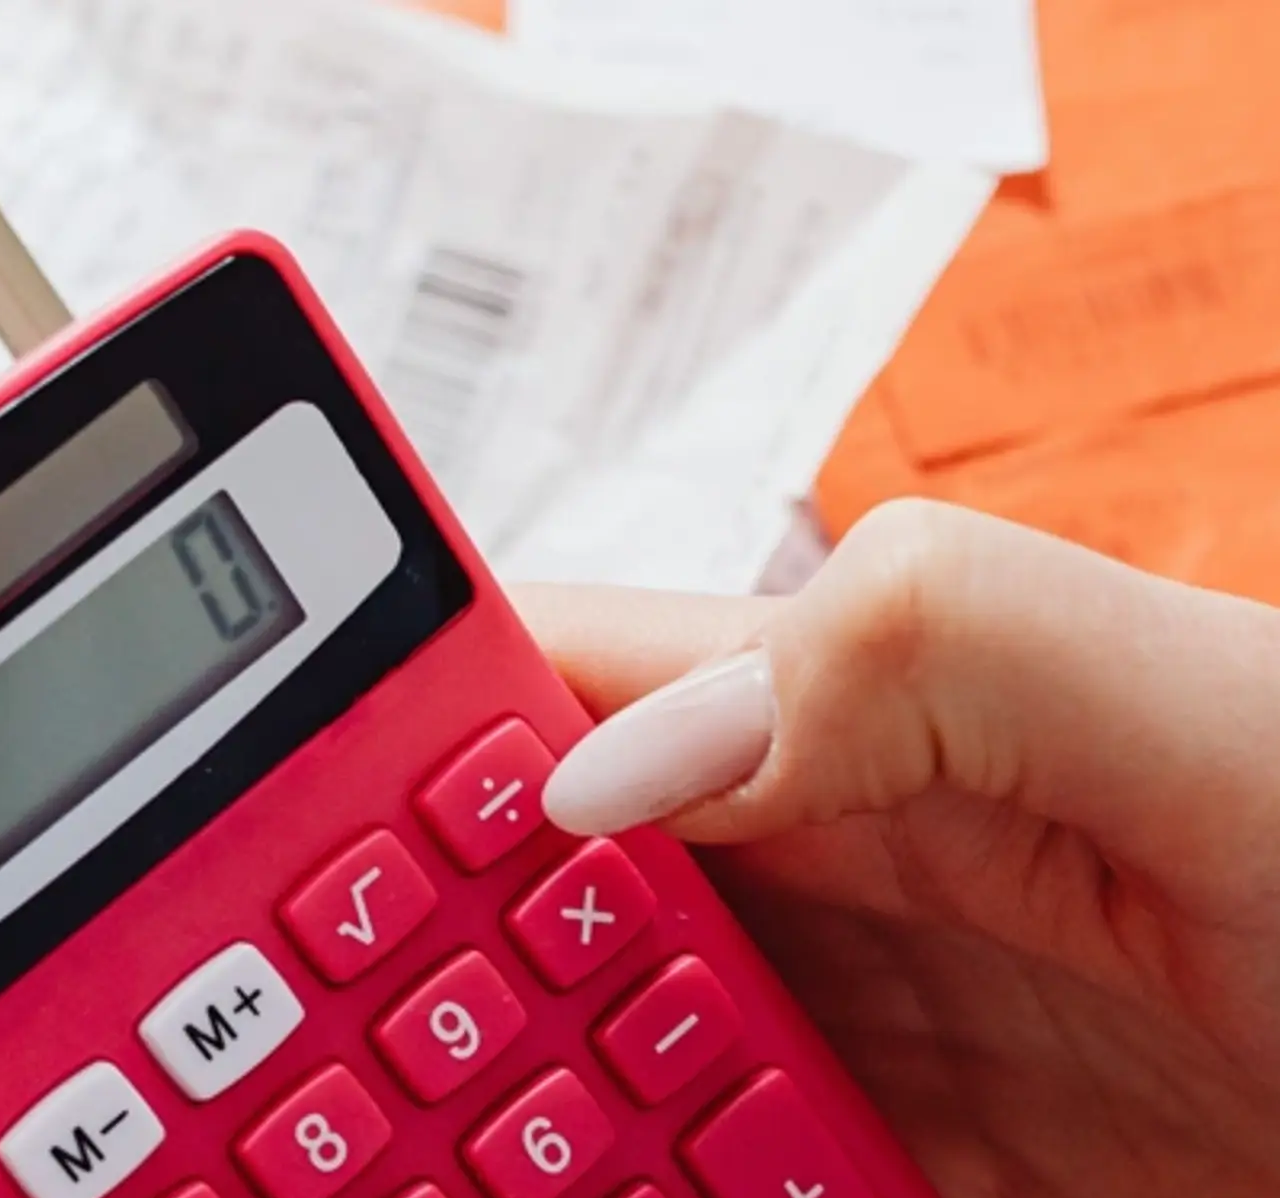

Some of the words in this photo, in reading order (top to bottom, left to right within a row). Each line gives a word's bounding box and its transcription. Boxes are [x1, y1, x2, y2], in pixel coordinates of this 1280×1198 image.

[183, 987, 261, 1061] M+
[430, 1001, 480, 1059] 9
[295, 1113, 347, 1172] 8
[523, 1117, 571, 1173] 6
